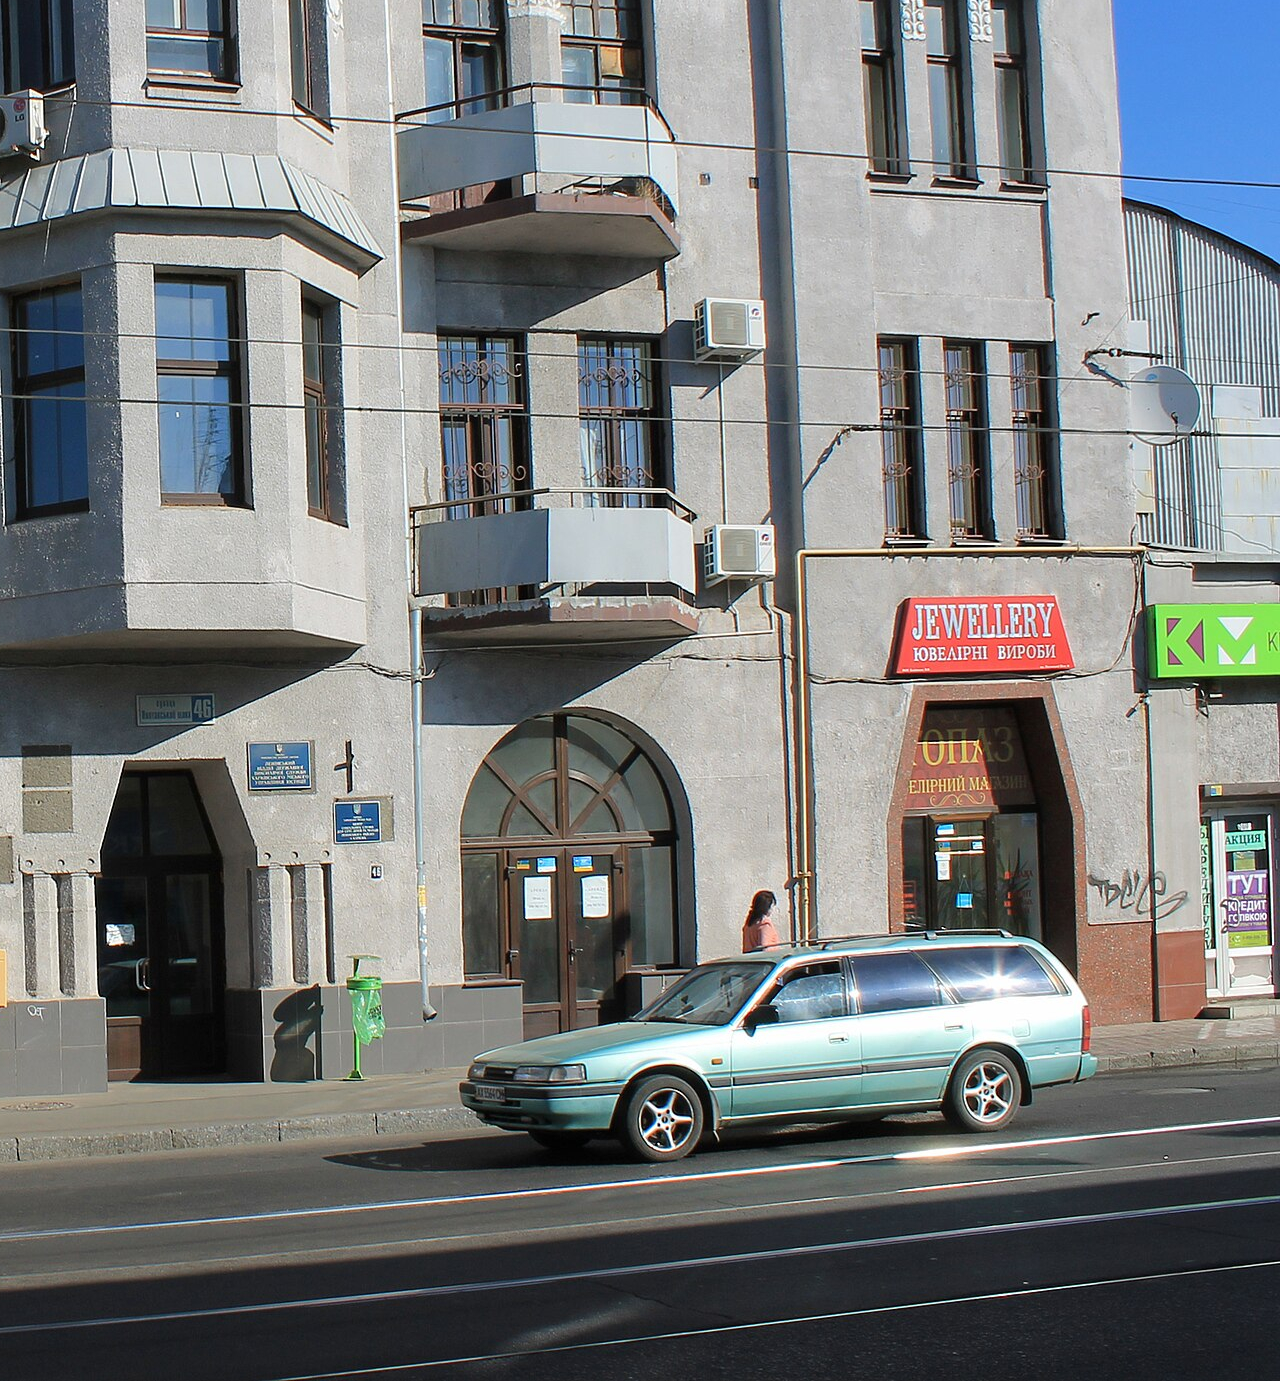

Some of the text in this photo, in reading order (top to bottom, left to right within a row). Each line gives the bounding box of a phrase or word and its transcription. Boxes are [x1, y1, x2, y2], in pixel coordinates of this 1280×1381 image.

[15, 114, 24, 122] LG
[912, 603, 1054, 640] JEWELLERY
[913, 644, 1057, 662] ЮВЕЛІРНІ ВИРОБИ
[194, 699, 212, 718] 46
[913, 726, 1014, 766] ОПАЗ
[1225, 833, 1262, 846] АКЦИЯ
[372, 866, 381, 877] 46
[1228, 873, 1267, 894] ТУТ
